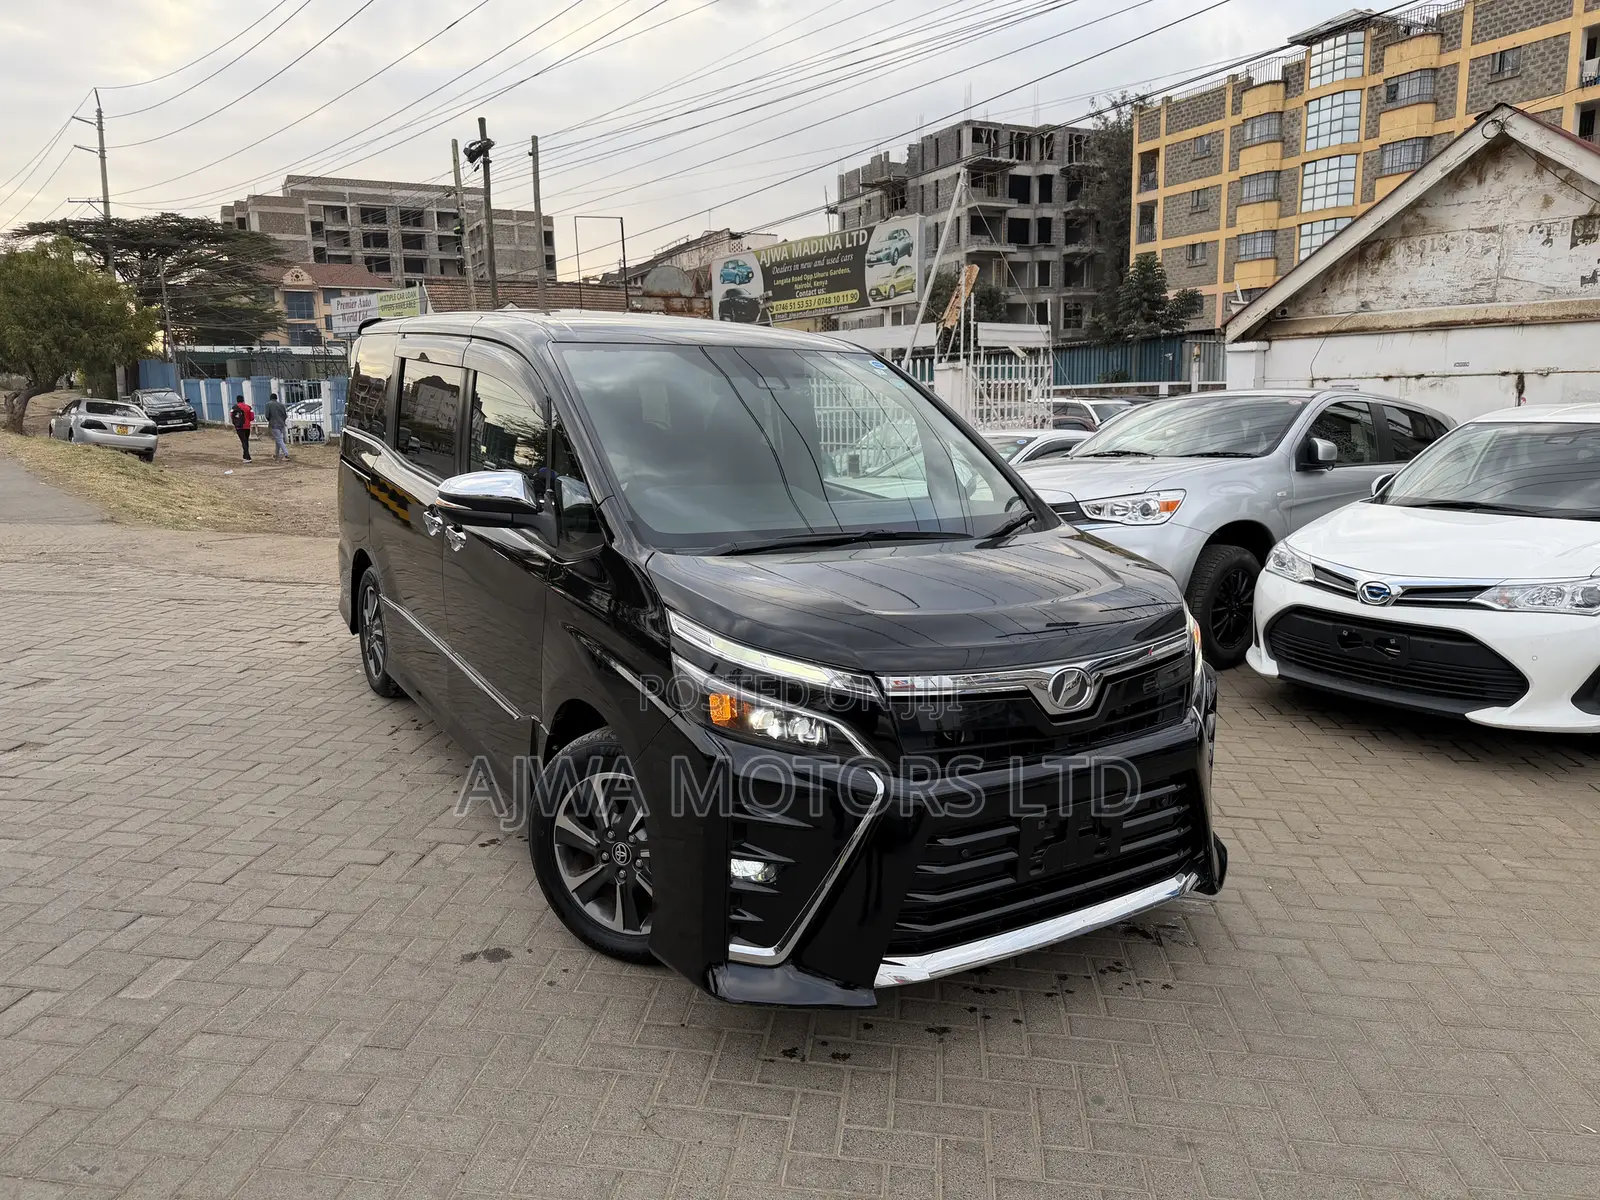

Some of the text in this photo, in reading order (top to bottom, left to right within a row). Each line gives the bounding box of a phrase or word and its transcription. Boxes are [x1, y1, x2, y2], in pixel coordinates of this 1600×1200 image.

[760, 228, 868, 267] AJWA MADINA LTD
[772, 252, 854, 275] Dealers in new and used cars
[814, 280, 828, 288] Kenya
[796, 288, 817, 298] Contact
[336, 298, 372, 310] Premier Auto
[774, 302, 789, 312] 0746
[789, 301, 796, 310] 51
[797, 300, 804, 309] 53
[805, 300, 812, 308] 53
[817, 296, 832, 306] 0748
[832, 295, 841, 303] 10
[842, 294, 848, 302] 11
[850, 292, 858, 301] 90
